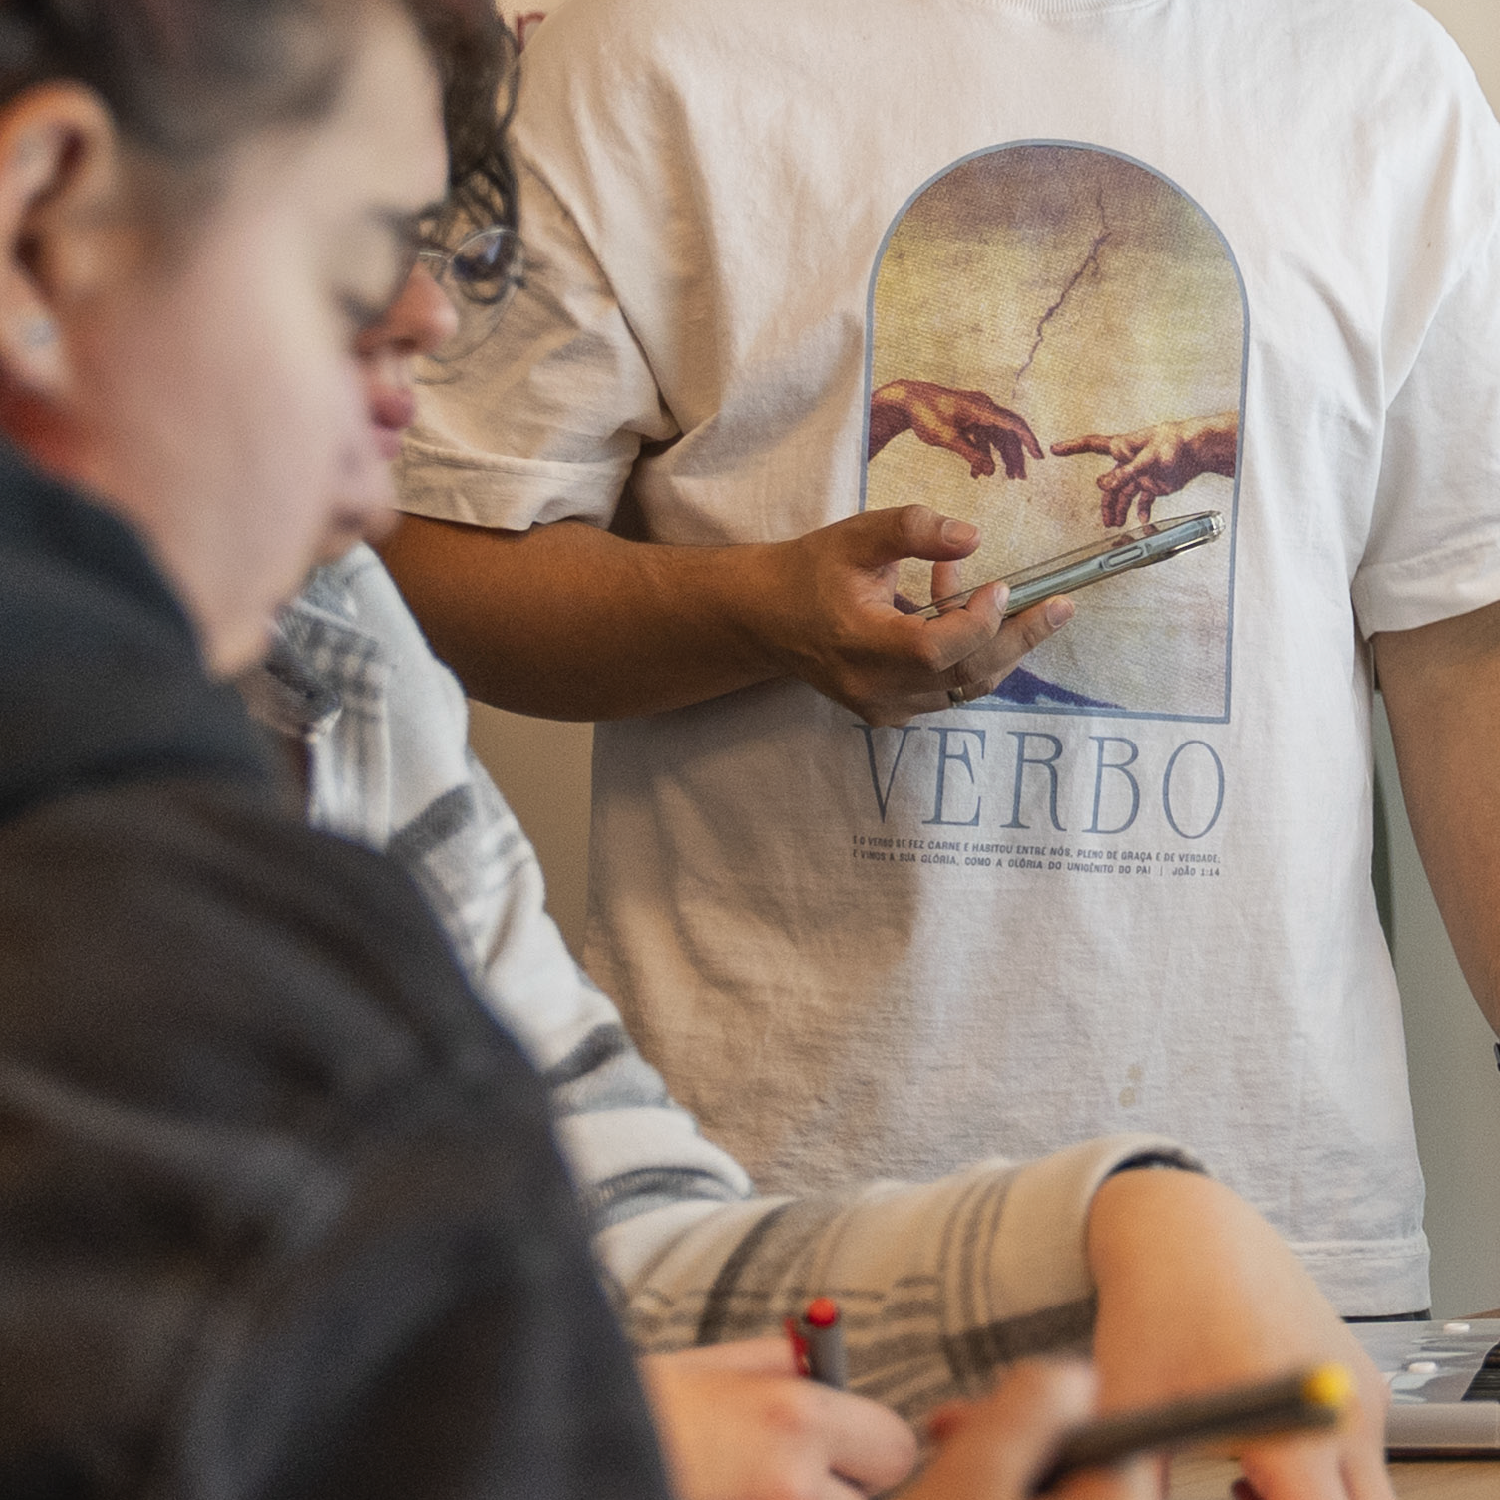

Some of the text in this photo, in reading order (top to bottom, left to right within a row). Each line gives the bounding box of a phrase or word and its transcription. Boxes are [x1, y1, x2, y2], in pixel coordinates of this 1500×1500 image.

[852, 724, 1226, 840] VERBO
[908, 840, 924, 850] FEZ
[927, 840, 960, 851] CARNE
[963, 843, 969, 852] E
[971, 843, 1013, 855] HABITOU
[1016, 845, 1047, 856] ENTRE
[1077, 849, 1103, 859] PLENO
[1106, 850, 1118, 860] DE
[1121, 851, 1152, 862] GRAÇA
[1155, 852, 1161, 861] E
[1164, 852, 1175, 862] DE
[920, 854, 960, 866] GLÓRIA,
[964, 856, 991, 867] COMO
[995, 858, 1003, 867] A
[1007, 858, 1043, 869] GLÓRIA
[1047, 861, 1062, 870] DO
[1067, 862, 1114, 874] UNIGÊNITO
[1118, 865, 1131, 874] DO
[1135, 865, 1152, 875] PAI
[1172, 865, 1196, 877] JOÃO
